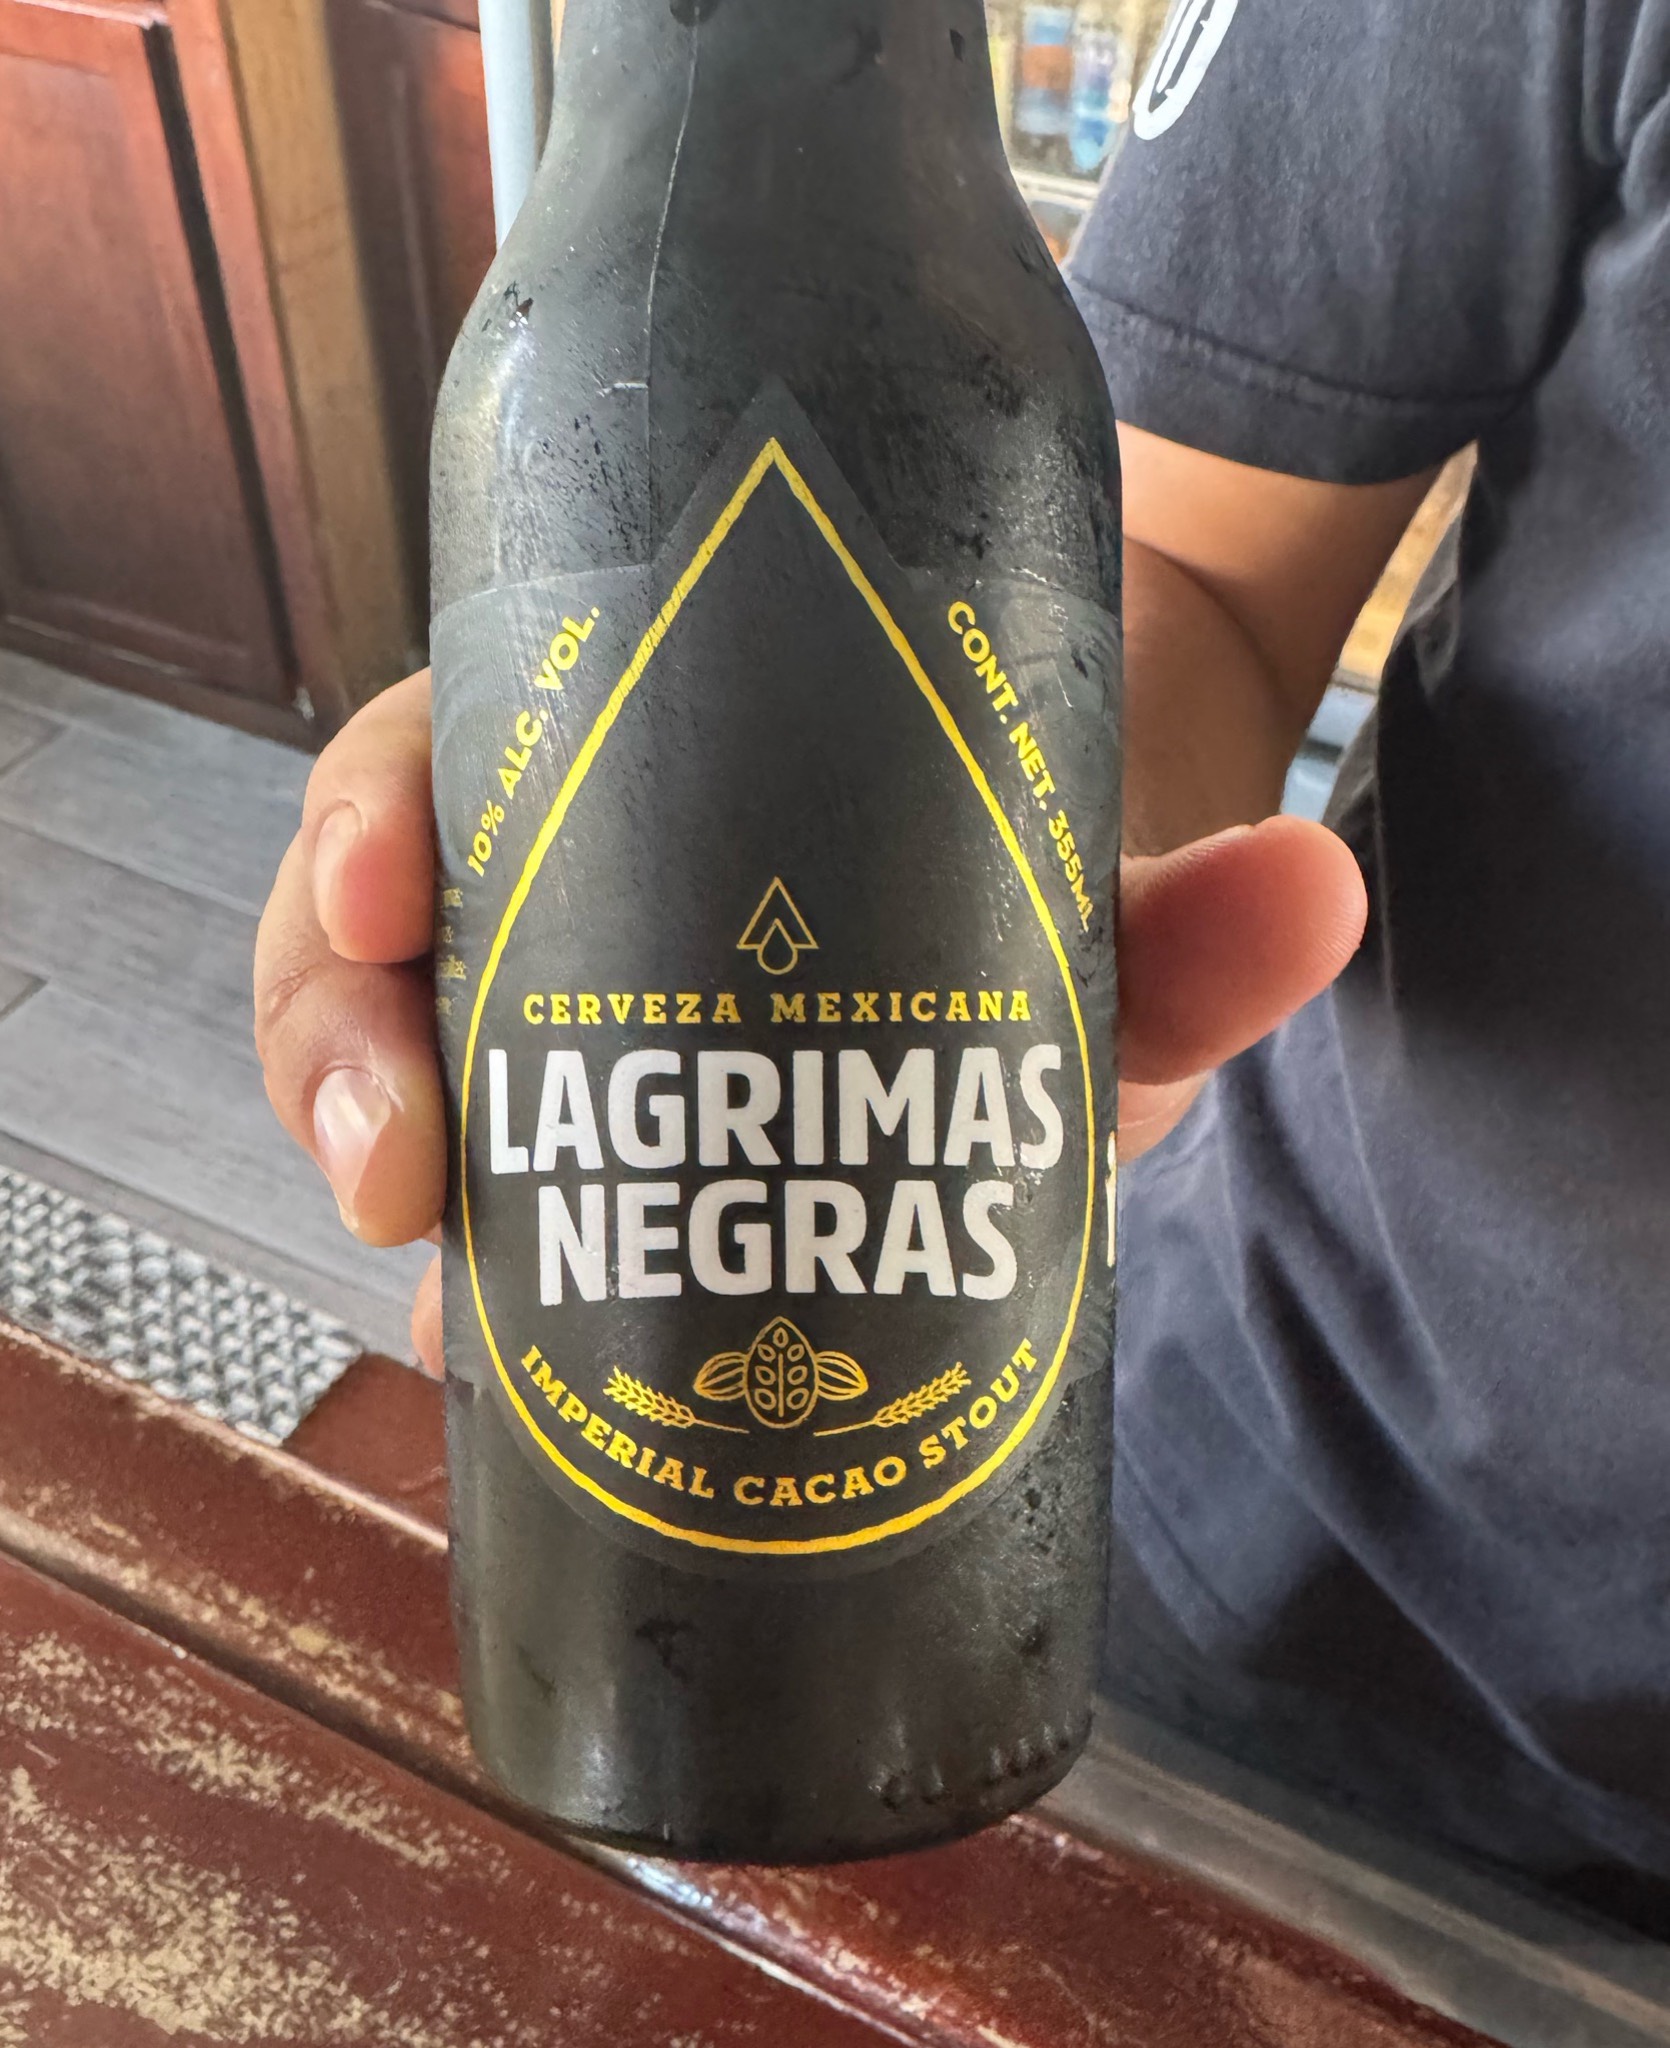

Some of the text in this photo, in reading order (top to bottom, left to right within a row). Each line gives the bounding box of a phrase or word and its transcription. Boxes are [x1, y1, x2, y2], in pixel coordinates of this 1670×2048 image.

[467, 606, 601, 877] 10% ALC. VOL.
[948, 600, 1019, 724] CONT.
[1008, 721, 1056, 811] NET.
[523, 990, 1032, 1026] CERVEZA MEXICANA
[488, 1044, 1065, 1175] LAGRIMAS
[538, 1178, 1018, 1307] NEGRAS
[520, 1337, 1038, 1507] IMPERIAL CACAO STOUT
